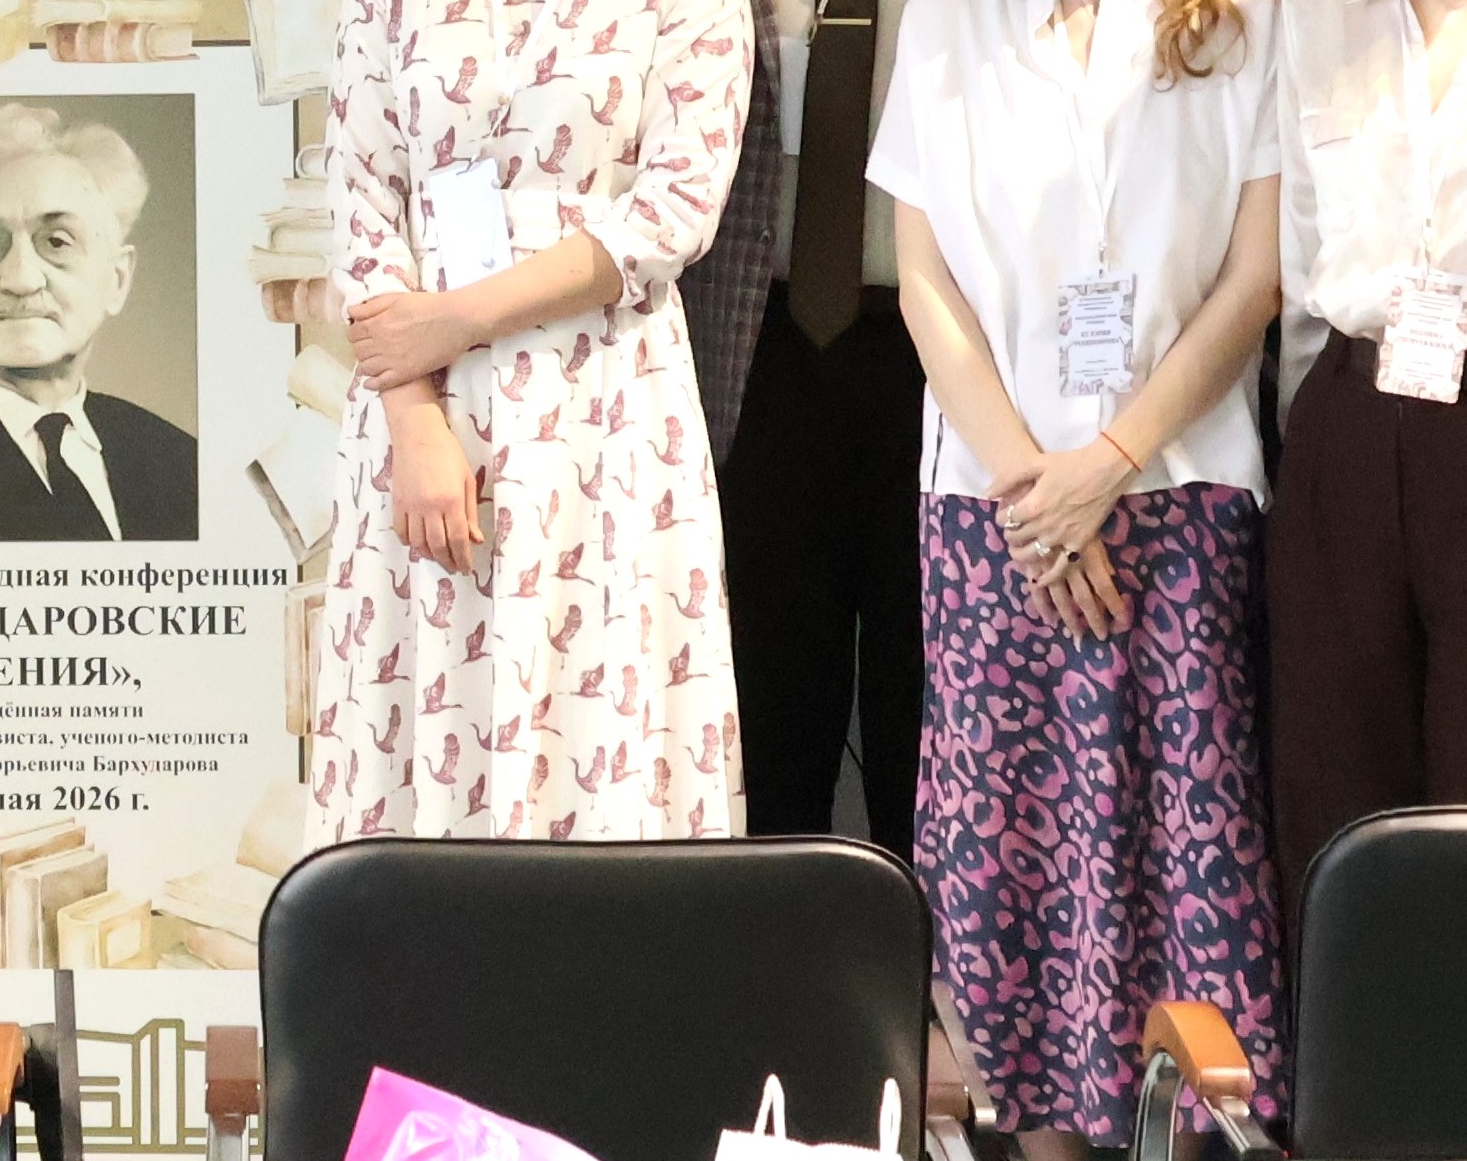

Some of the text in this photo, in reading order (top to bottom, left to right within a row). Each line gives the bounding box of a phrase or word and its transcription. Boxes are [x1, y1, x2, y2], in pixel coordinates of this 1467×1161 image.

[80, 561, 288, 595] конференция
[69, 706, 144, 719] памяти
[60, 733, 249, 750] ученого-методиста
[93, 755, 219, 776] Бархударова
[53, 786, 121, 811] 2026
[131, 793, 149, 811] г.
